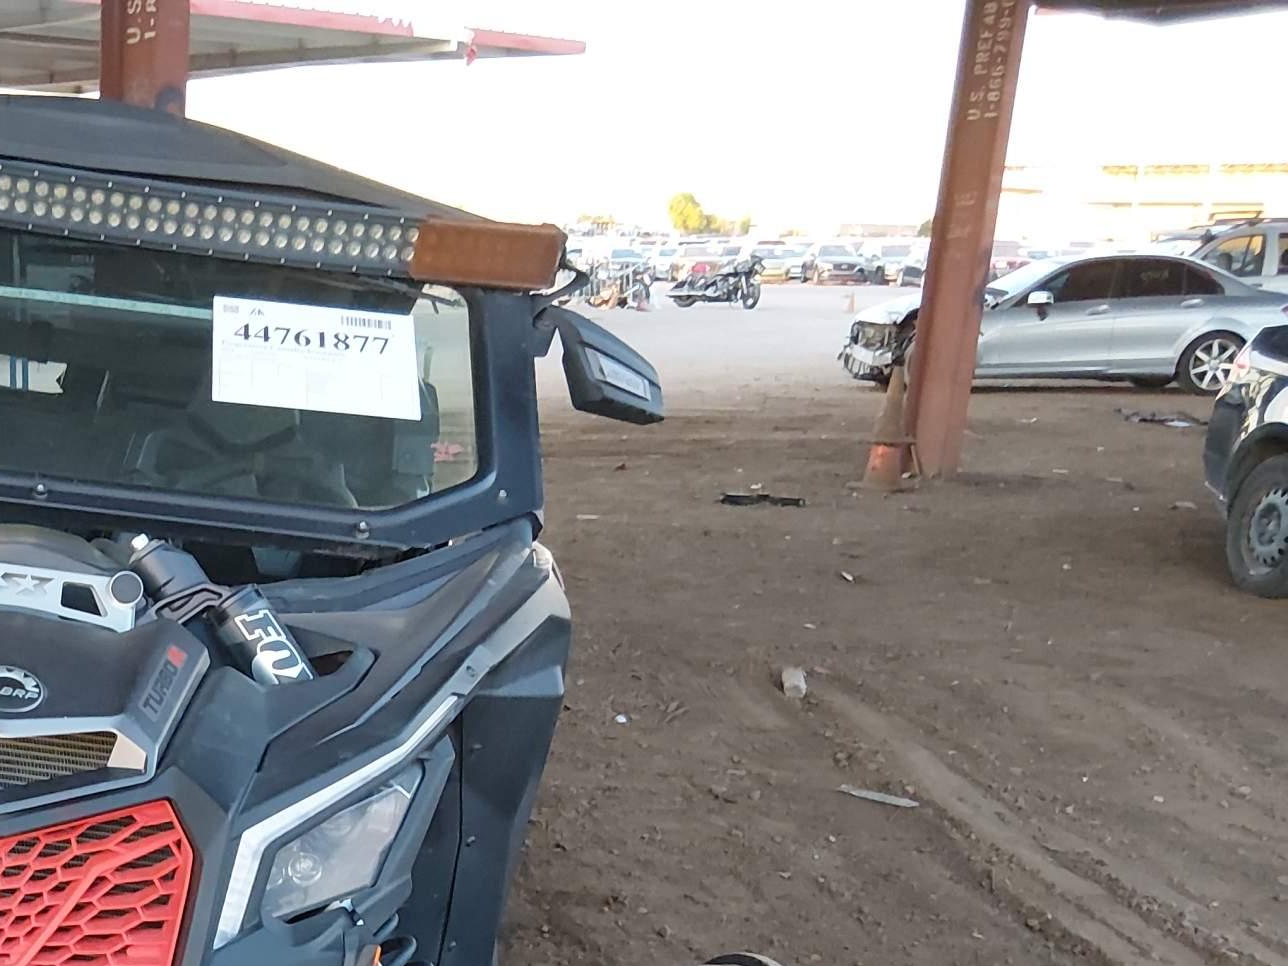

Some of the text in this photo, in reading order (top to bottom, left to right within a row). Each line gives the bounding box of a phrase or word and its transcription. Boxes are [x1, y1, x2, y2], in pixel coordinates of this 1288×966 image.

[234, 322, 390, 355] 44761877
[0, 685, 40, 701] BRP
[142, 659, 179, 715] TURBO
